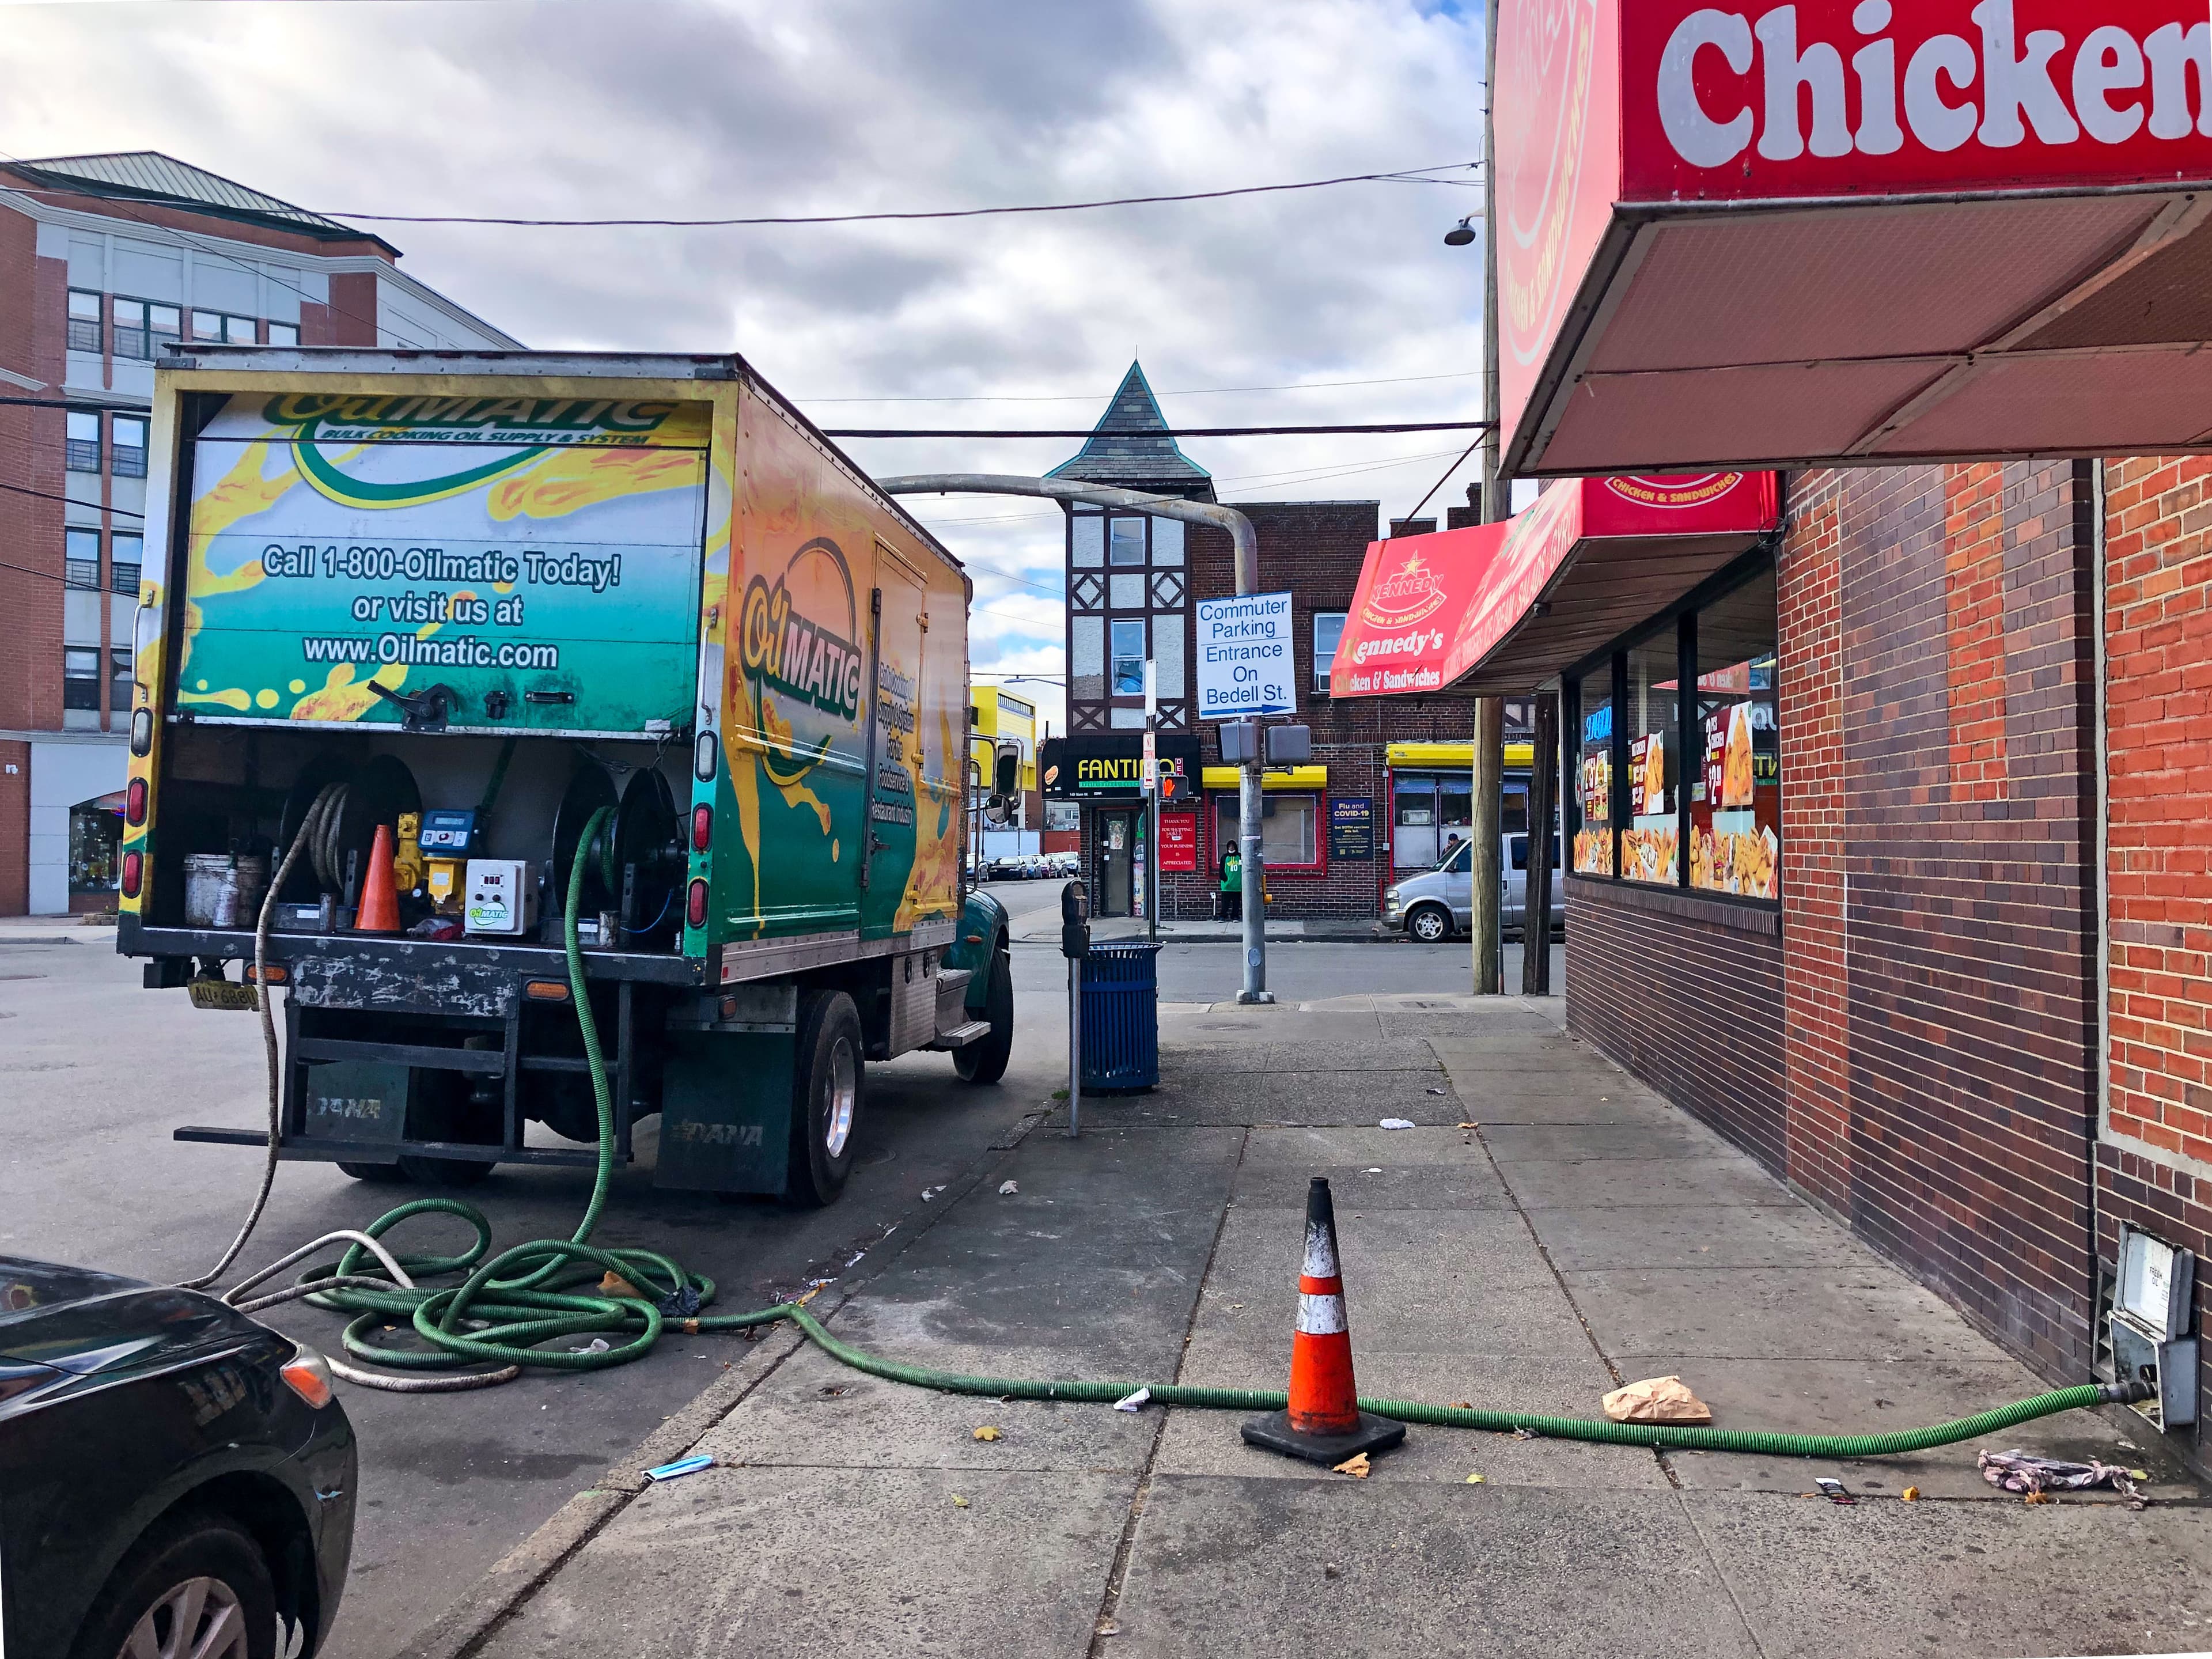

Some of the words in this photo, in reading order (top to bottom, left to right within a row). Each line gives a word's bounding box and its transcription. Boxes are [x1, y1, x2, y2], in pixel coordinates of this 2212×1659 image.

[1657, 0, 2212, 168] Chicken
[321, 430, 368, 440] BULK
[366, 430, 453, 440] COOKING
[453, 432, 483, 441] OIL
[487, 432, 556, 441] SUPPLY
[558, 433, 573, 442] &
[576, 434, 650, 444] SYSTEM
[1613, 479, 1655, 501] CHICKEN
[1657, 493, 1668, 502] &
[1671, 473, 1736, 502] SANDWICHES
[262, 544, 313, 576] Call
[322, 547, 519, 582] 1-800-Oilmatic
[524, 551, 622, 593] Today!
[1371, 574, 1444, 601] KENNEDY
[352, 597, 384, 622] or
[387, 591, 449, 623] visit
[454, 597, 488, 625] us
[494, 594, 524, 626] at
[1200, 600, 1287, 621] Commuter
[1213, 619, 1275, 639] Parking
[304, 633, 559, 670] www.Oilmatic.com
[1207, 644, 1282, 662] Entrance
[1342, 628, 1444, 665] Kennedy's
[1233, 666, 1257, 682] On
[1373, 671, 1381, 690] &
[1383, 667, 1440, 690] Sandwiches
[1207, 685, 1259, 704] Bedell
[1264, 684, 1287, 701] St.
[1706, 718, 1711, 762] 3
